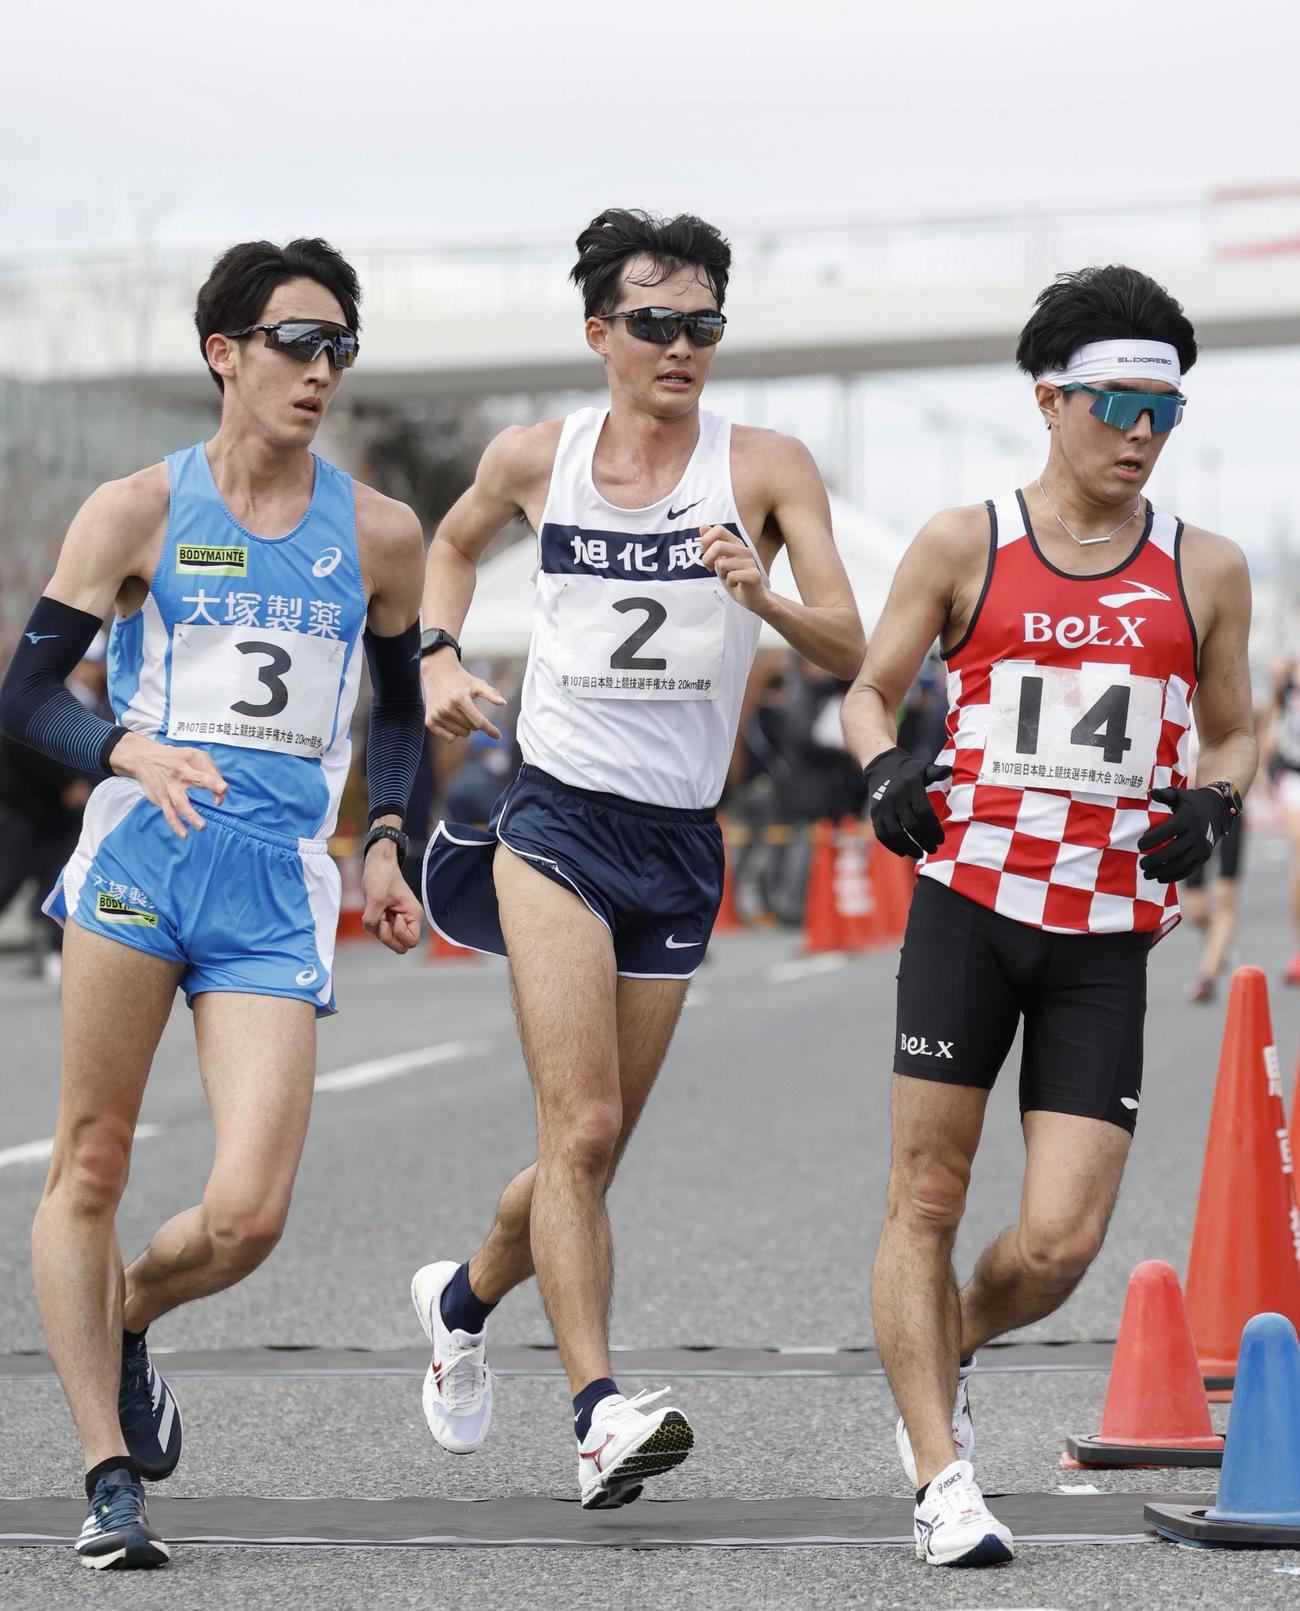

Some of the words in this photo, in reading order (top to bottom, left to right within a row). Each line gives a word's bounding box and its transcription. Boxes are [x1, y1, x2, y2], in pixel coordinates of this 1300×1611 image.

[179, 549, 245, 562] BODYMAINTÉ
[181, 589, 343, 641] 大塚製薬
[609, 597, 667, 671] 2
[230, 641, 292, 718] 3
[1015, 676, 1132, 764] 14
